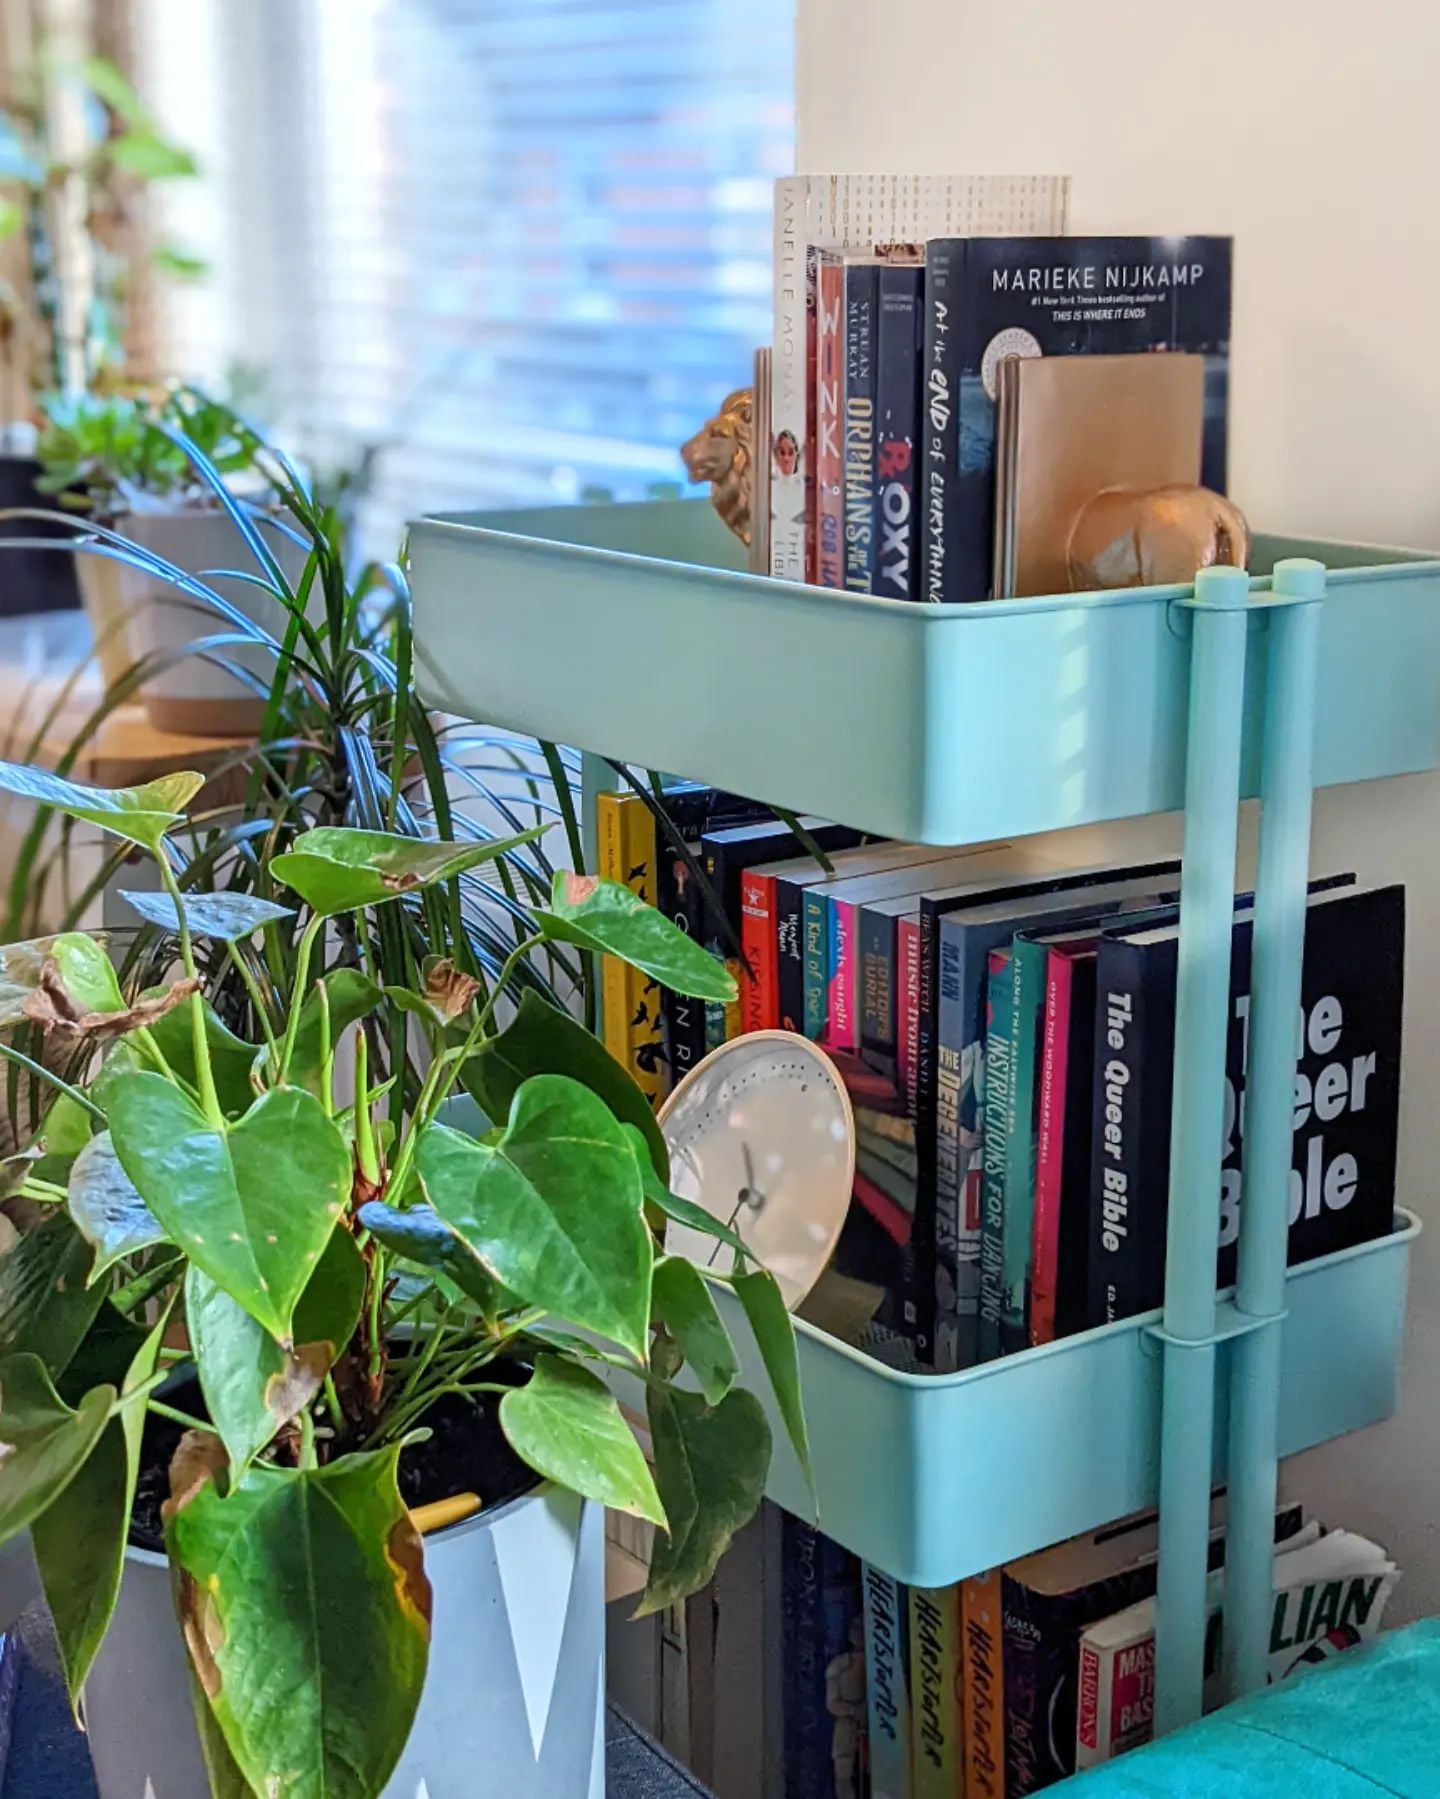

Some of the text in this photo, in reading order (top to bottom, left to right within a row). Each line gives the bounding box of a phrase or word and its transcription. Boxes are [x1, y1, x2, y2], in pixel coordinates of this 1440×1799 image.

[781, 187, 796, 300] JANELLE
[992, 264, 1204, 292] MARIEKE NIJKAMP
[848, 301, 859, 380] MURRAY
[859, 301, 870, 379] STRUAN
[1053, 307, 1147, 322] THIS IS WHERE IT ENDS
[846, 397, 873, 545] ORPHANS
[788, 530, 799, 567] THE
[807, 904, 820, 916] A
[807, 921, 822, 956] Kind
[836, 919, 848, 967] alexis
[808, 960, 823, 980] of
[864, 952, 877, 1019] BURIAL
[907, 934, 920, 1004] music
[940, 940, 960, 1000] MANN
[1012, 957, 1023, 1006] ALONG
[1048, 981, 1057, 1017] OVER
[907, 1007, 920, 1062] from
[1011, 1011, 1020, 1036] THE
[1047, 1020, 1056, 1044] THE
[983, 1032, 1010, 1179] INSTRUCTIONS
[1043, 1048, 1054, 1128] WOODWARD
[1102, 990, 1132, 1253] The Queer Bible
[935, 1047, 961, 1250] THE DEGENERATES
[985, 1181, 1002, 1227] FOR
[980, 1234, 1004, 1323] DANCING
[1268, 1576, 1385, 1655] LIAN
[866, 1568, 898, 1741] HEARTSTOPPER
[914, 1594, 945, 1769] HEARTSTOPPER
[966, 1619, 996, 1797] HEARTSTOPPER
